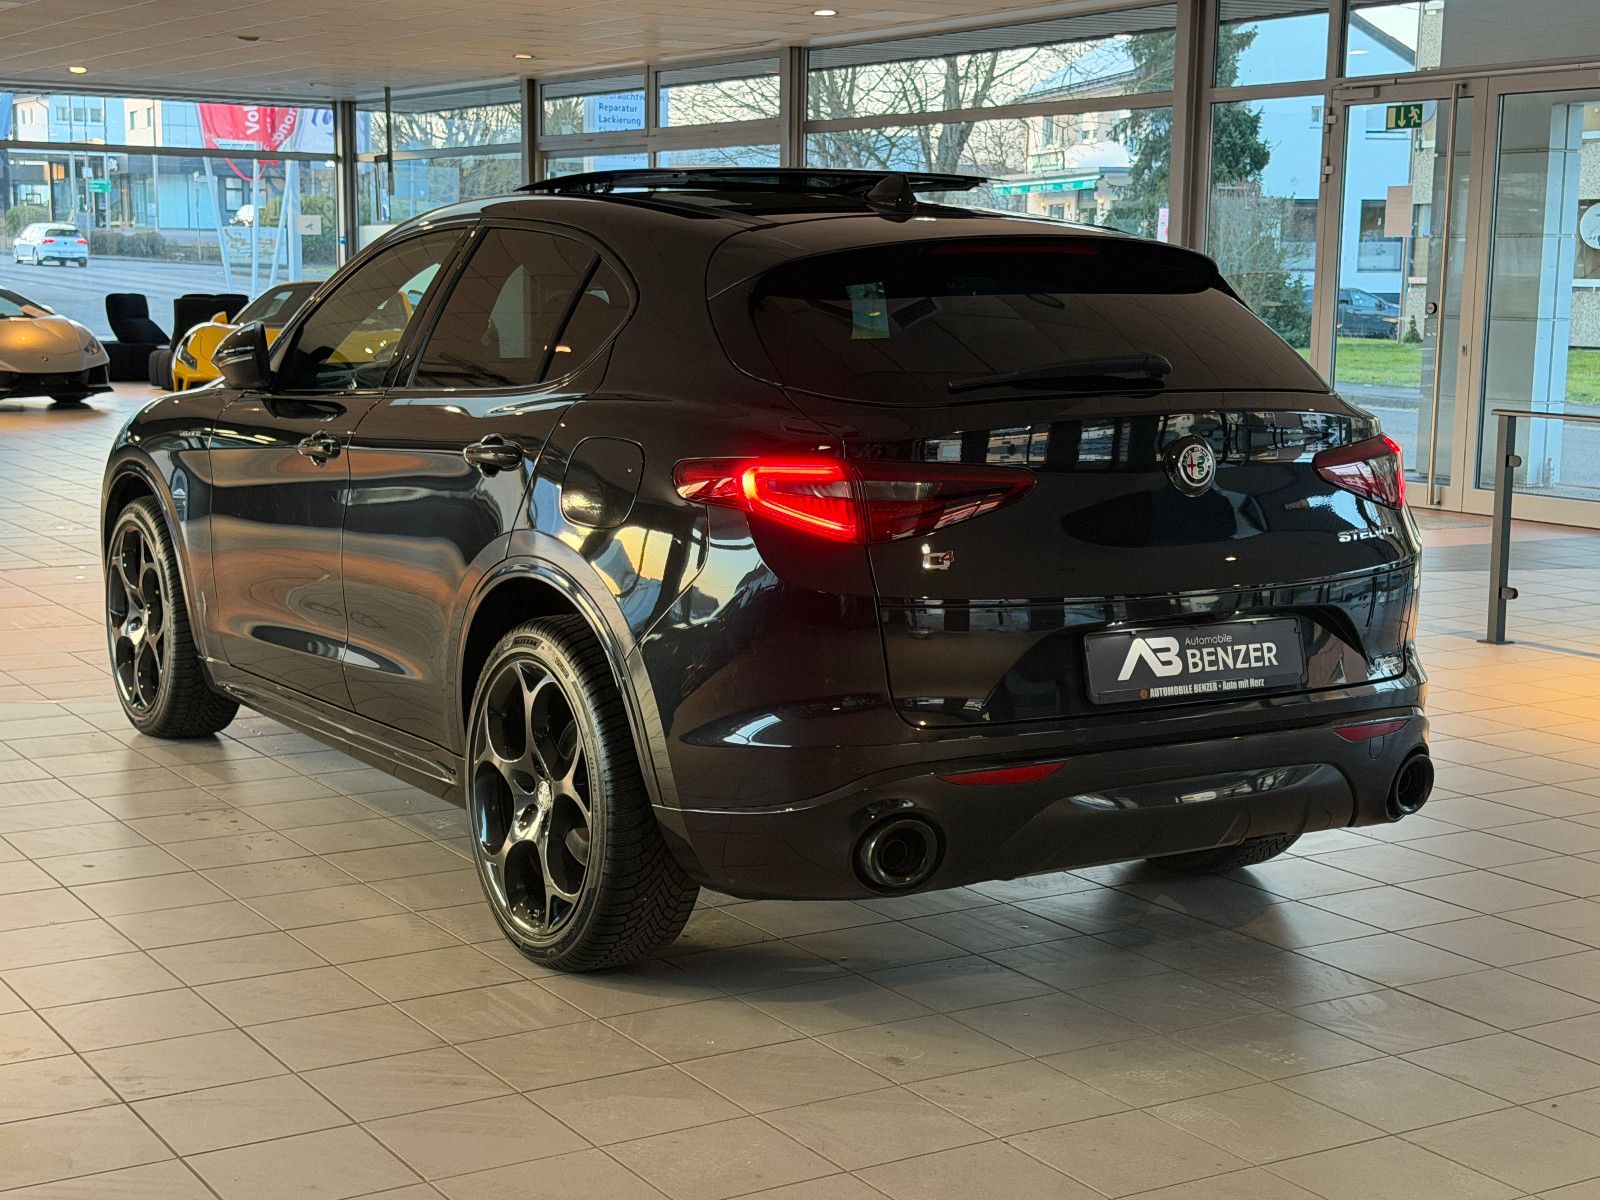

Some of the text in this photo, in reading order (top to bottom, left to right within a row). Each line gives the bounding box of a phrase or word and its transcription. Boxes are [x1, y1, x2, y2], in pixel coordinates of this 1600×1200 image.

[598, 102, 638, 113] Reparatur
[598, 115, 642, 126] Lackierung
[1184, 633, 1233, 646] Automobile
[1117, 636, 1182, 681] AB
[1186, 642, 1279, 674] BENZER
[1150, 678, 1265, 698] AUTOMOBILE BENZER Auto mit Herz
